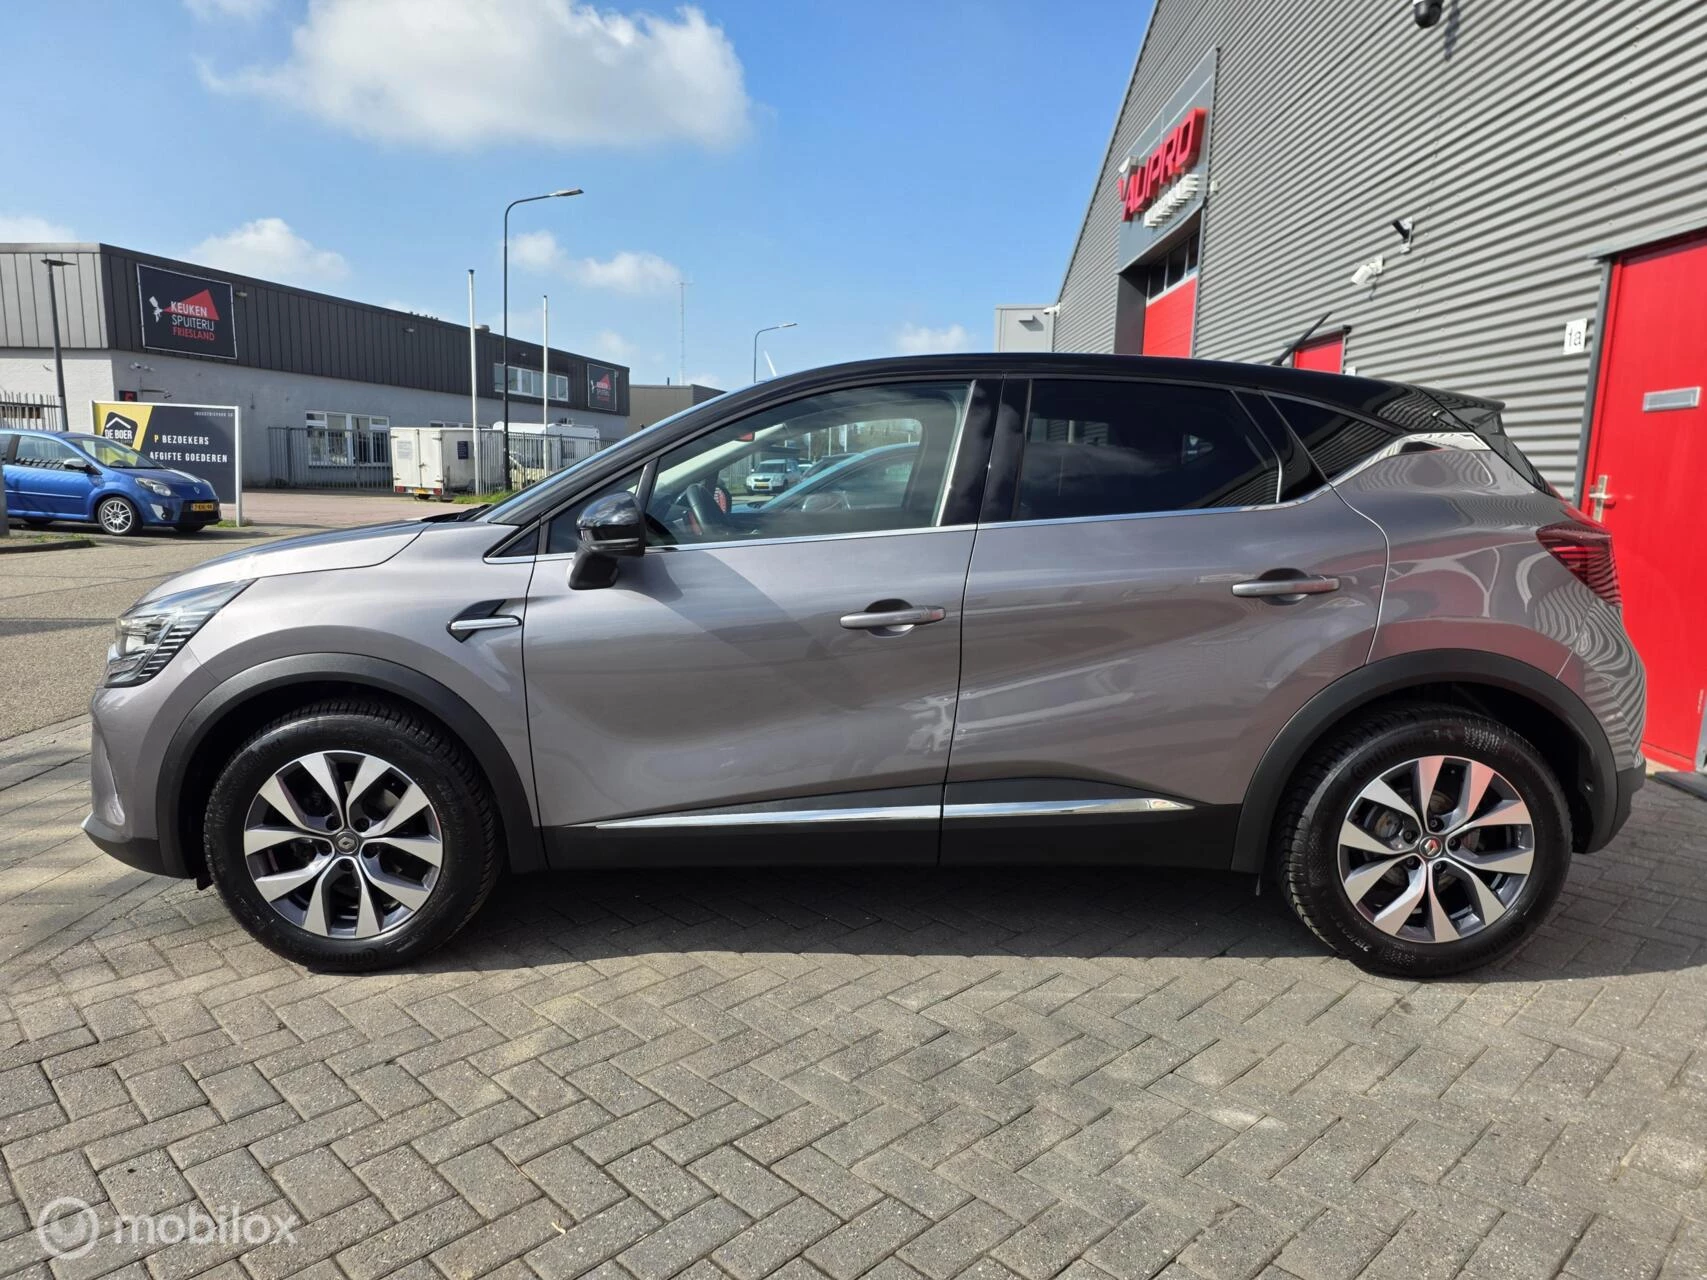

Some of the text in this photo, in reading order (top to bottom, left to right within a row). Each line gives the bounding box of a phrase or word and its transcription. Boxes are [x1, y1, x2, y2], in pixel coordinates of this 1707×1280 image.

[170, 301, 208, 317] KEUKEN
[171, 314, 215, 331] SPUITERIJ
[172, 327, 215, 341] FRIESLAND
[105, 429, 133, 440] DE BOER
[162, 435, 209, 445] BEZOEKERS
[149, 451, 228, 463] AFGIFTE GOEDEREN
